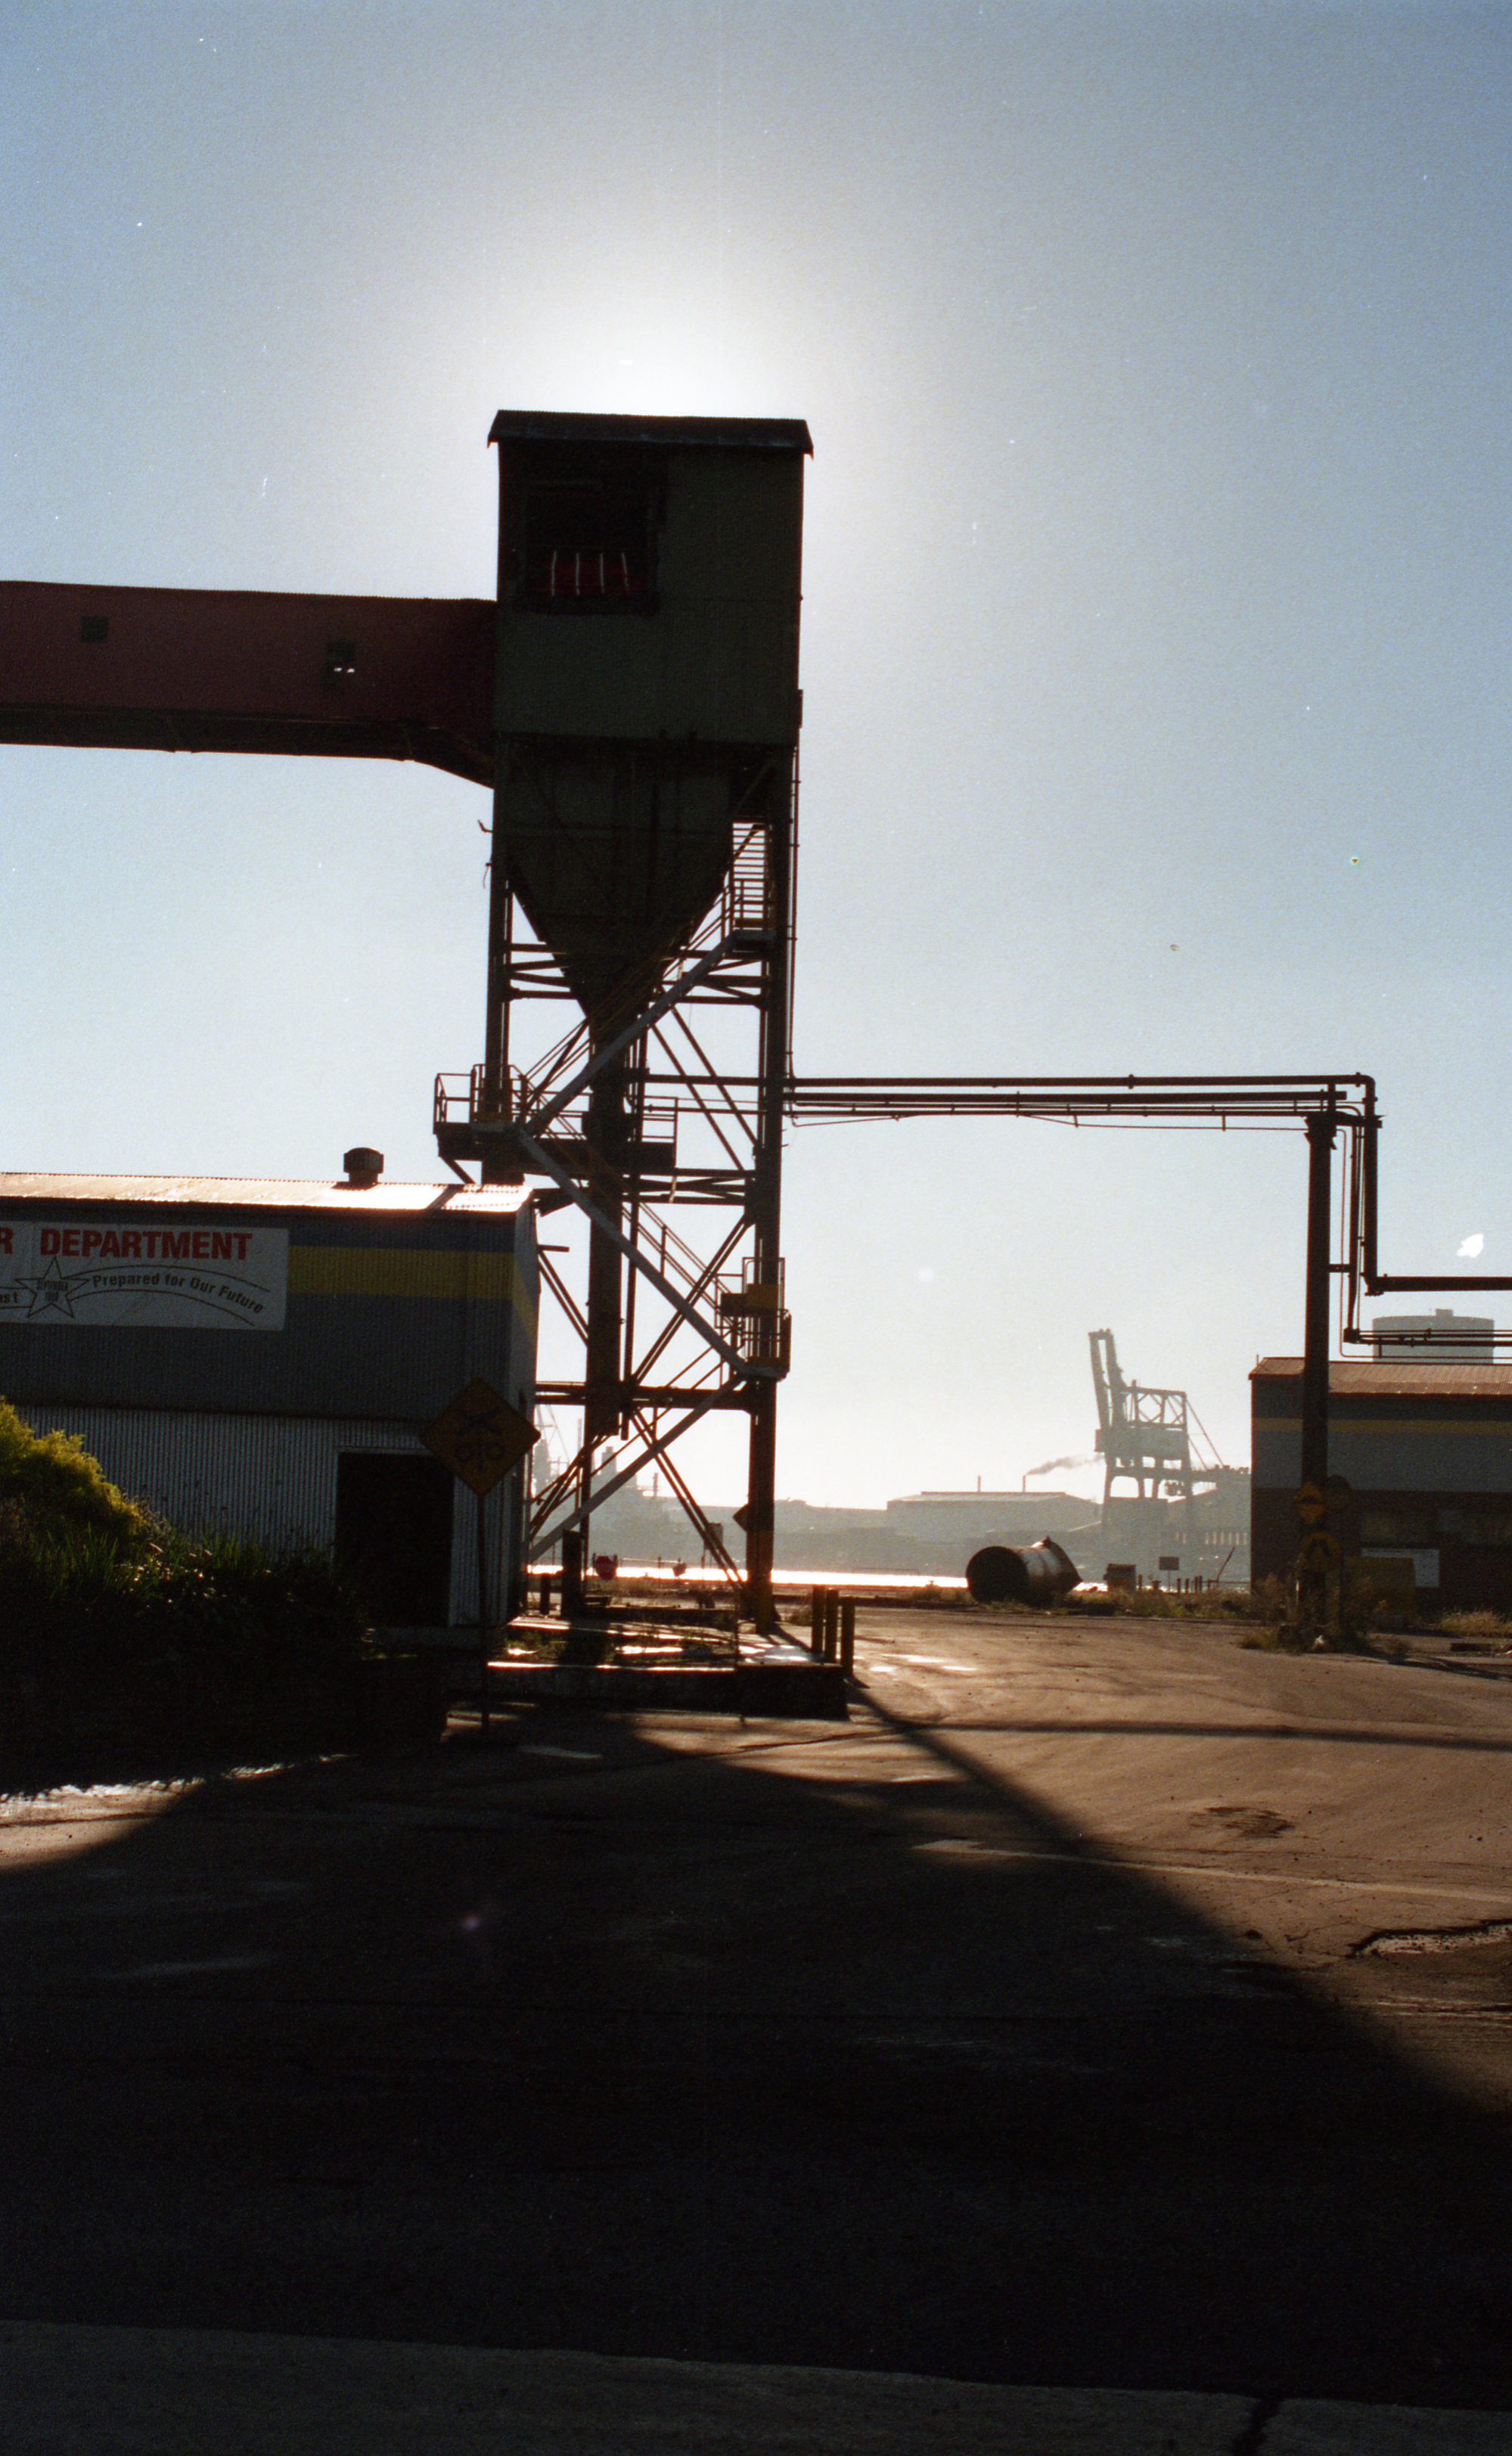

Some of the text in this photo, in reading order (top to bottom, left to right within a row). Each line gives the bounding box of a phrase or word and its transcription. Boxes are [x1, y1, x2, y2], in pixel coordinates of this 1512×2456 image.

[41, 1229, 253, 1260] DEPARTMENT
[92, 1273, 263, 1314] Prepared for Our Future
